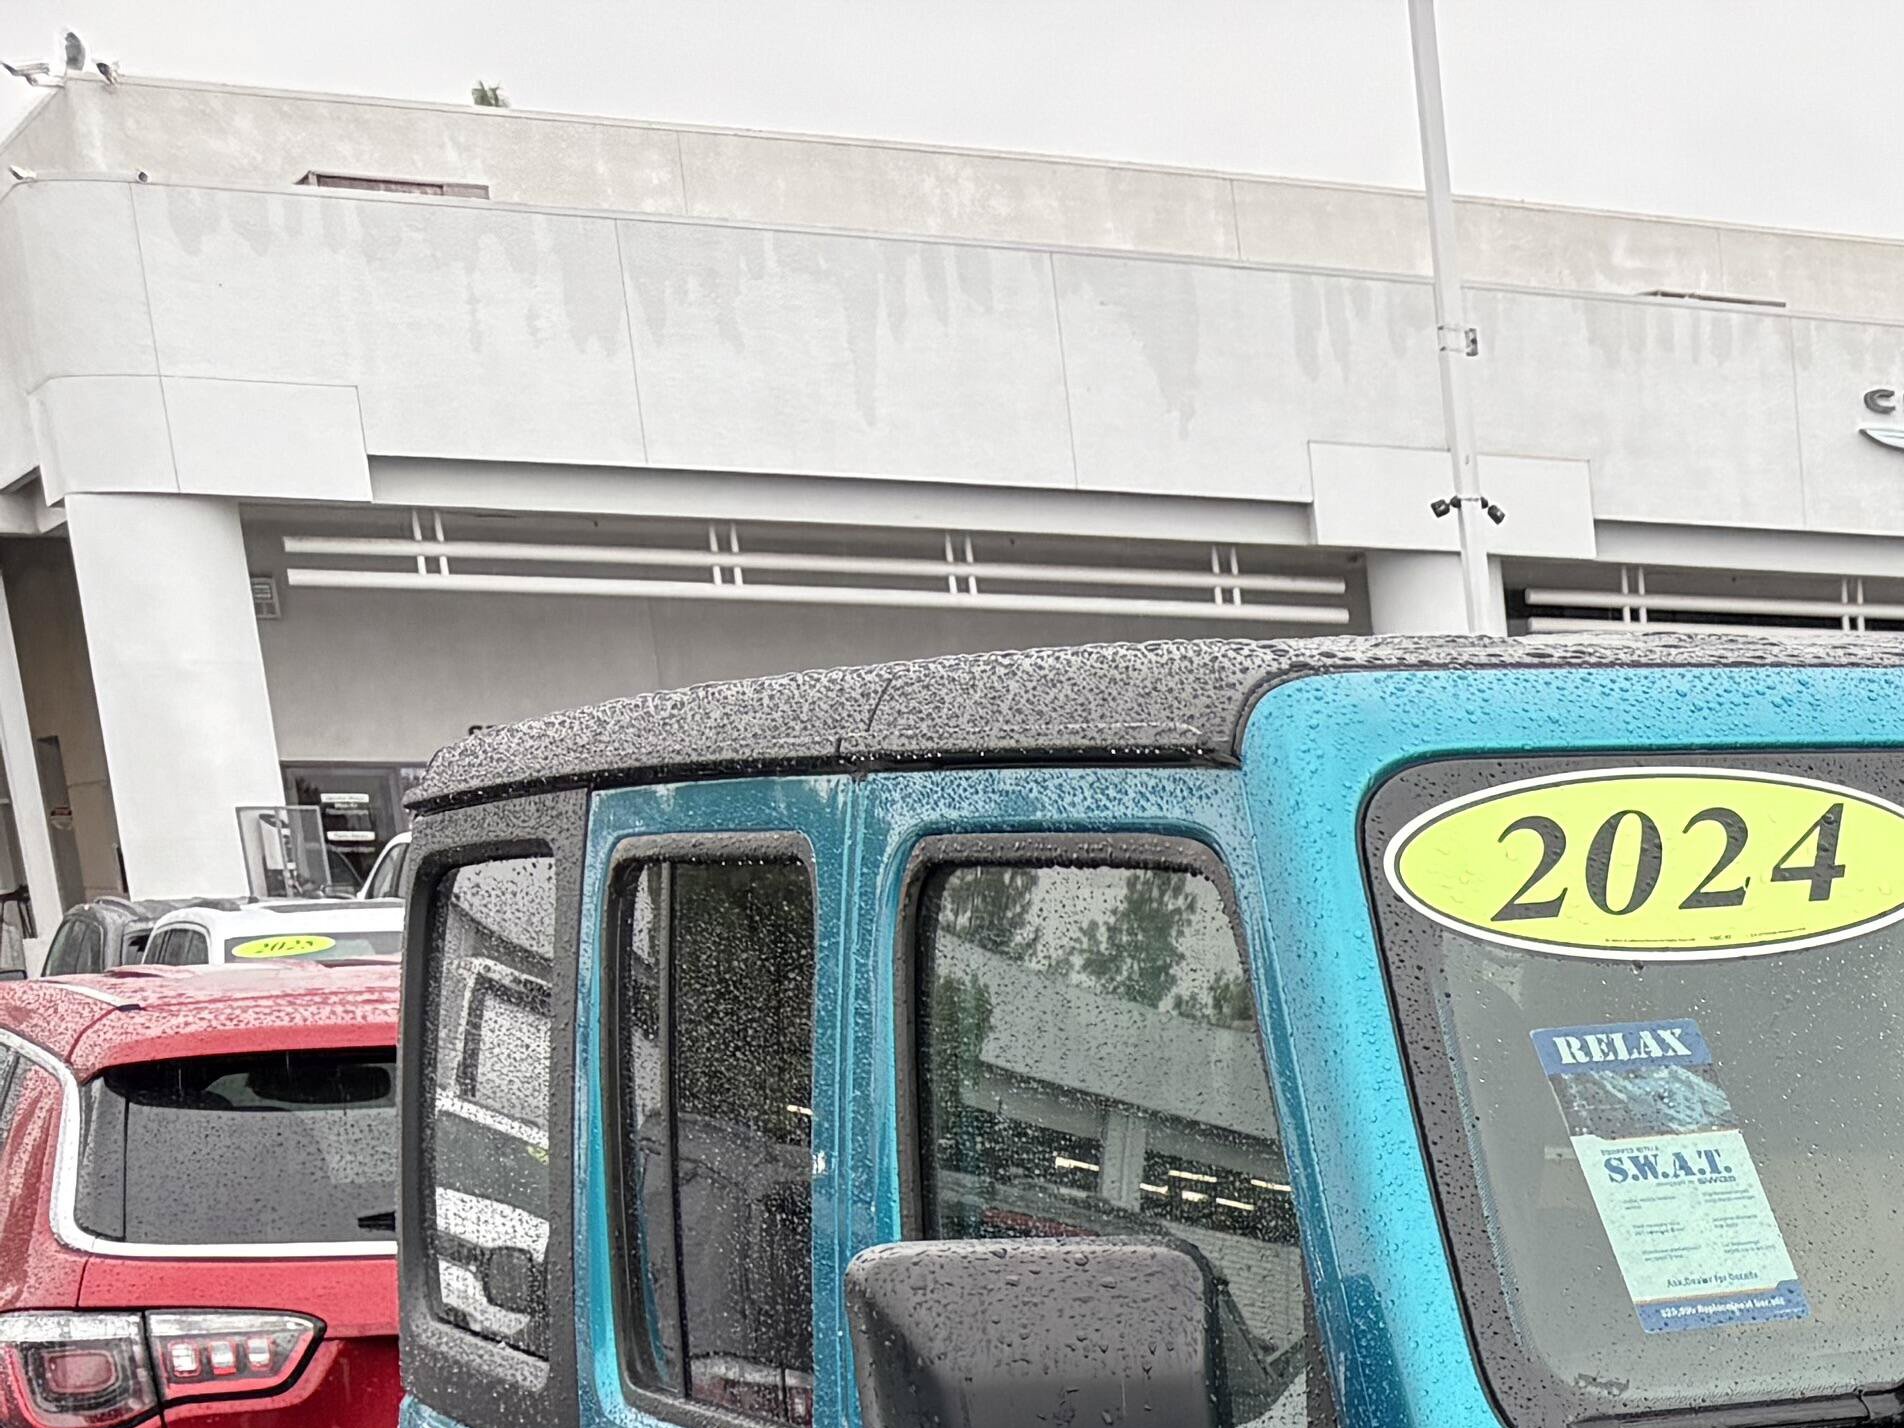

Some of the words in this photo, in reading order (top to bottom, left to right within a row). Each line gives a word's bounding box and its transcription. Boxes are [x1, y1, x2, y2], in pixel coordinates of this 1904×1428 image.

[1491, 802, 1847, 922] 2024
[1553, 1028, 1692, 1064] RELAX
[1604, 1149, 1733, 1184] S.W.A.T.
